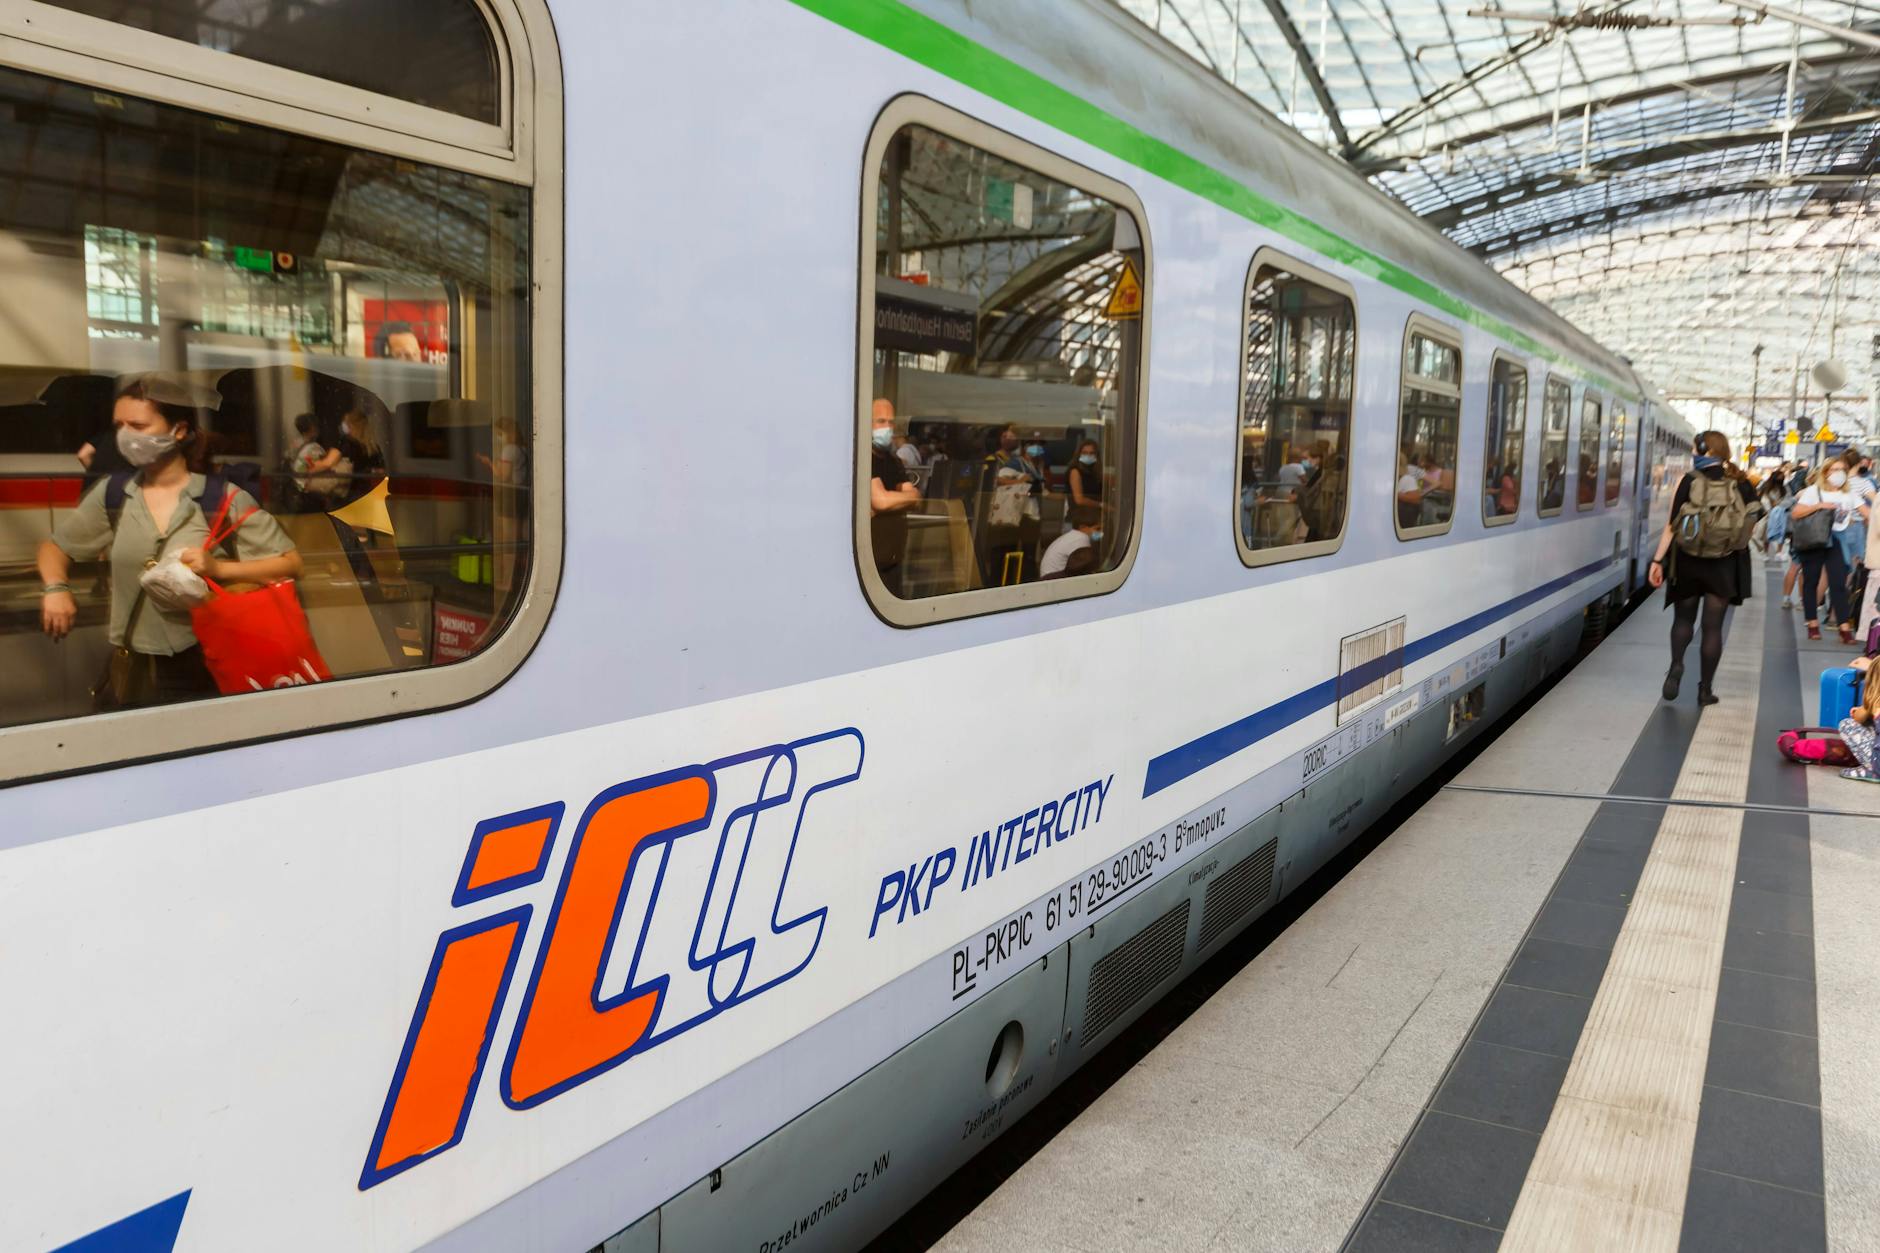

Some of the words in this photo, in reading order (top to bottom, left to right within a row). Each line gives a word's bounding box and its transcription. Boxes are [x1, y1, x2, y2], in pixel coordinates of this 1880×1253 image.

[868, 846, 957, 939] PKP
[961, 774, 1115, 892] INTERCITY
[952, 911, 1034, 1001] PL-PKPIC
[1046, 898, 1061, 931] 61
[1069, 885, 1083, 919] 51
[852, 1172, 869, 1195] Cz
[872, 1150, 892, 1183] NN
